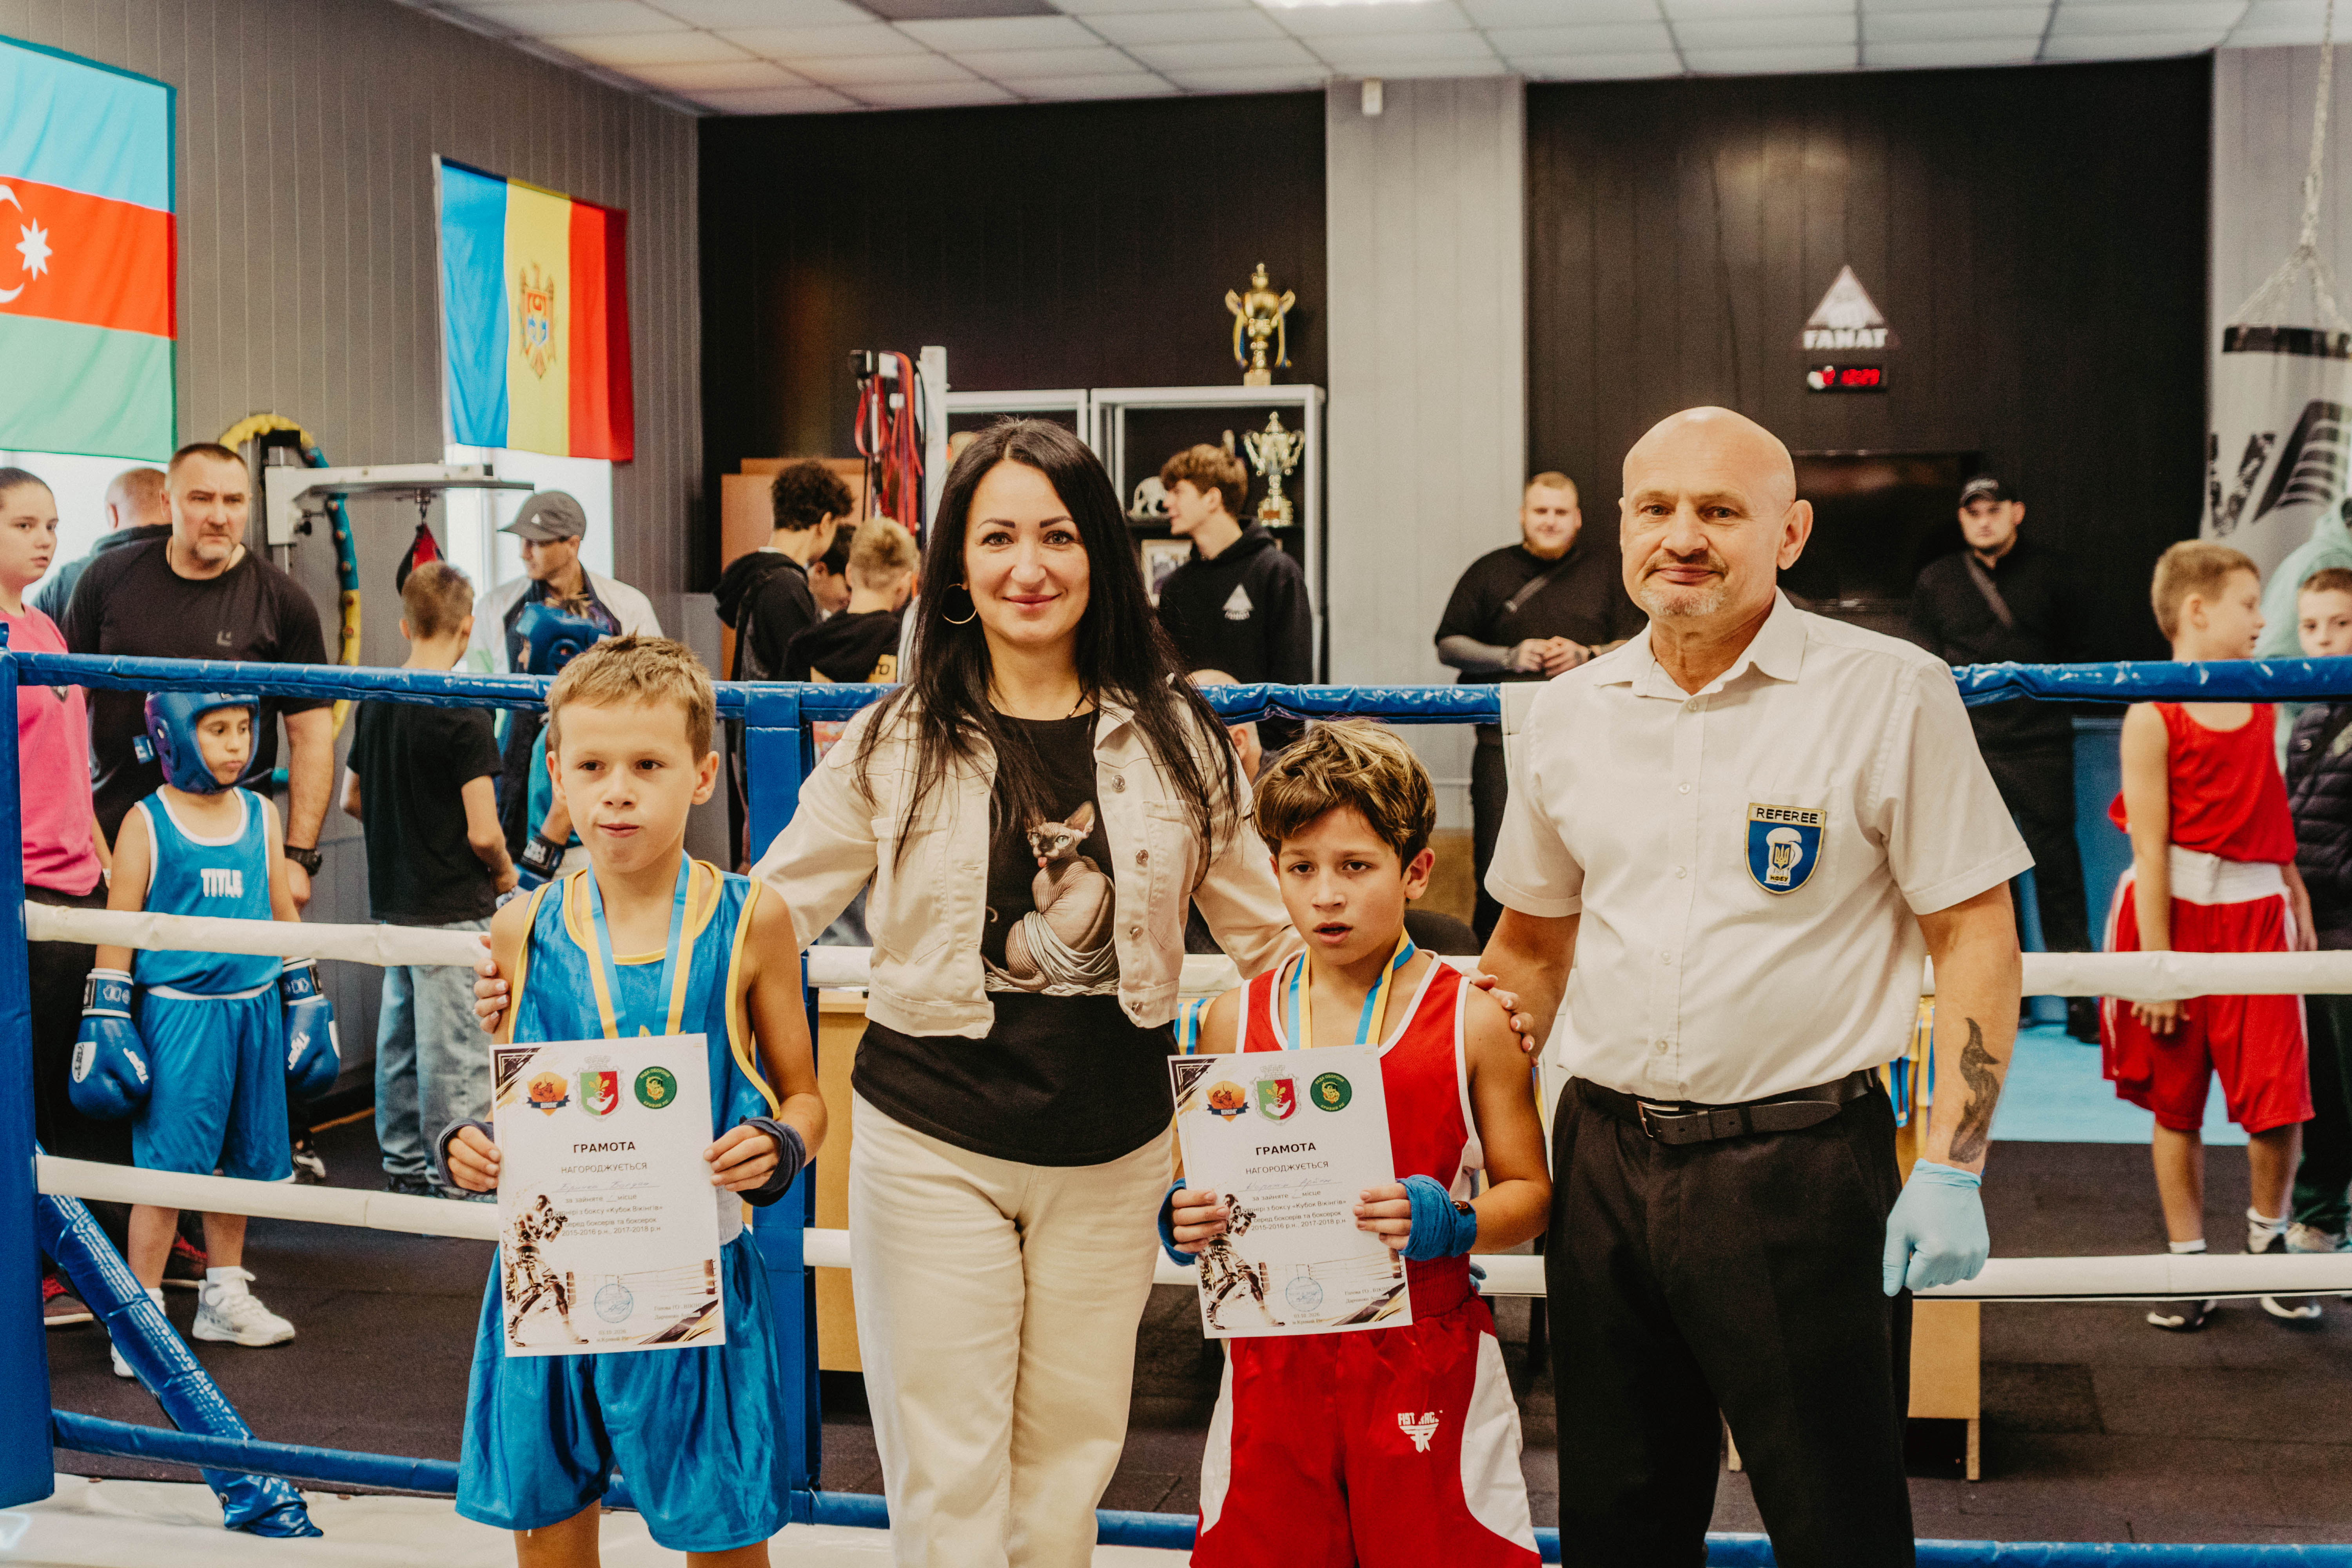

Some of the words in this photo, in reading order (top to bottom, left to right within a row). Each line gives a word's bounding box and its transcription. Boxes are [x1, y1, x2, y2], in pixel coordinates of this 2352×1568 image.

[1757, 808, 1818, 824] REFEREE
[200, 868, 243, 898] TITLE
[1315, 1076, 1325, 1085] РАДА
[573, 1142, 635, 1153] ГРАМОТА
[1256, 1142, 1316, 1155] ГРАМОТА
[561, 1162, 647, 1173] НАГОРОДЖУЄТЬСЯ
[1245, 1161, 1329, 1174] НАГОРОДЖУЄТЬСЯ
[1397, 1412, 1415, 1426] FIST
